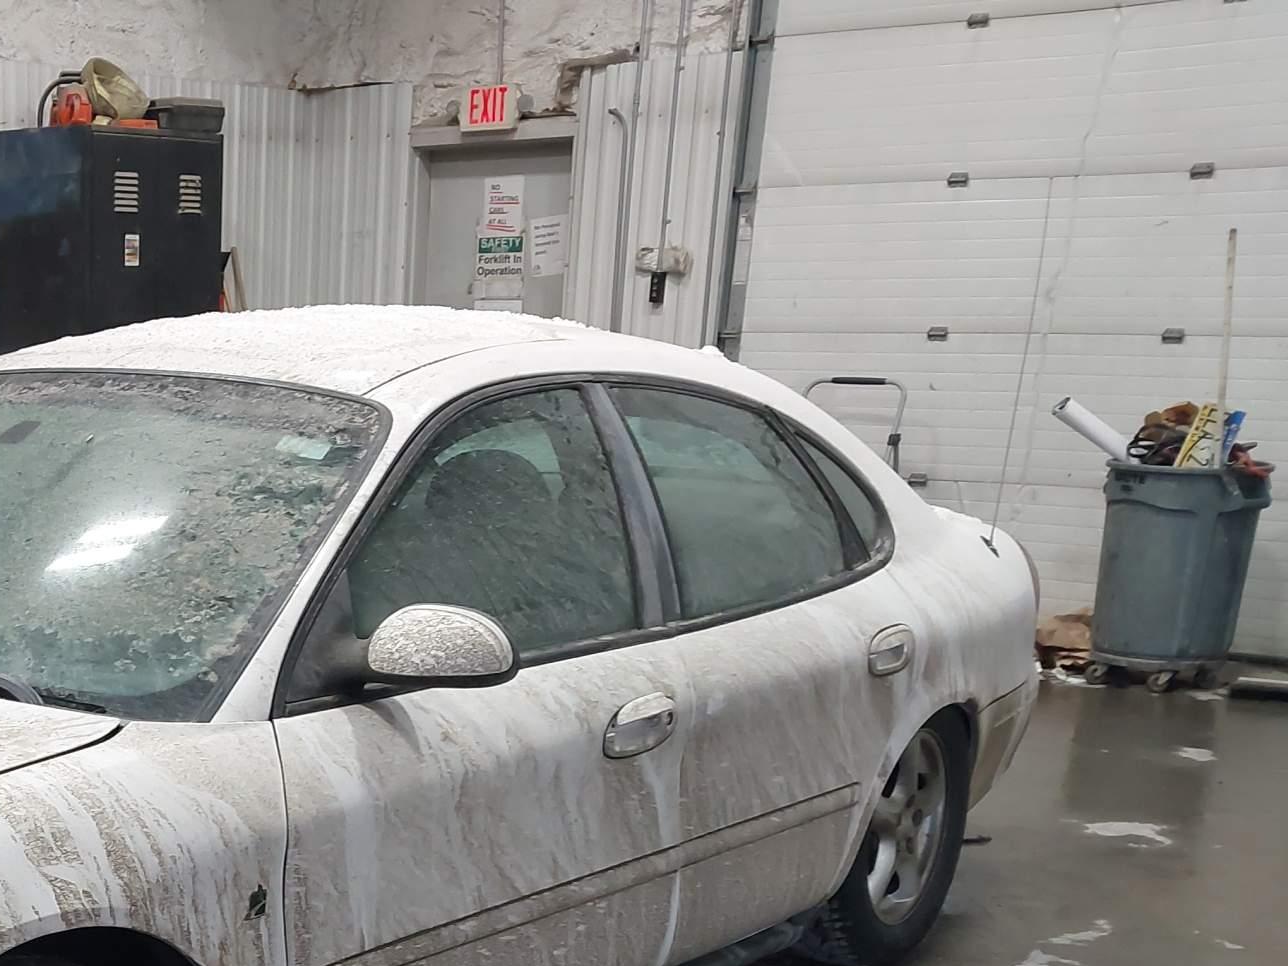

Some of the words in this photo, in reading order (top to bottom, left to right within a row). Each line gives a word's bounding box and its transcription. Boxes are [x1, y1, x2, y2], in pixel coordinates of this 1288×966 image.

[469, 87, 508, 125] EXIT
[480, 237, 521, 248] SAFETY
[478, 254, 511, 264] Forklift
[476, 266, 522, 278] Operation
